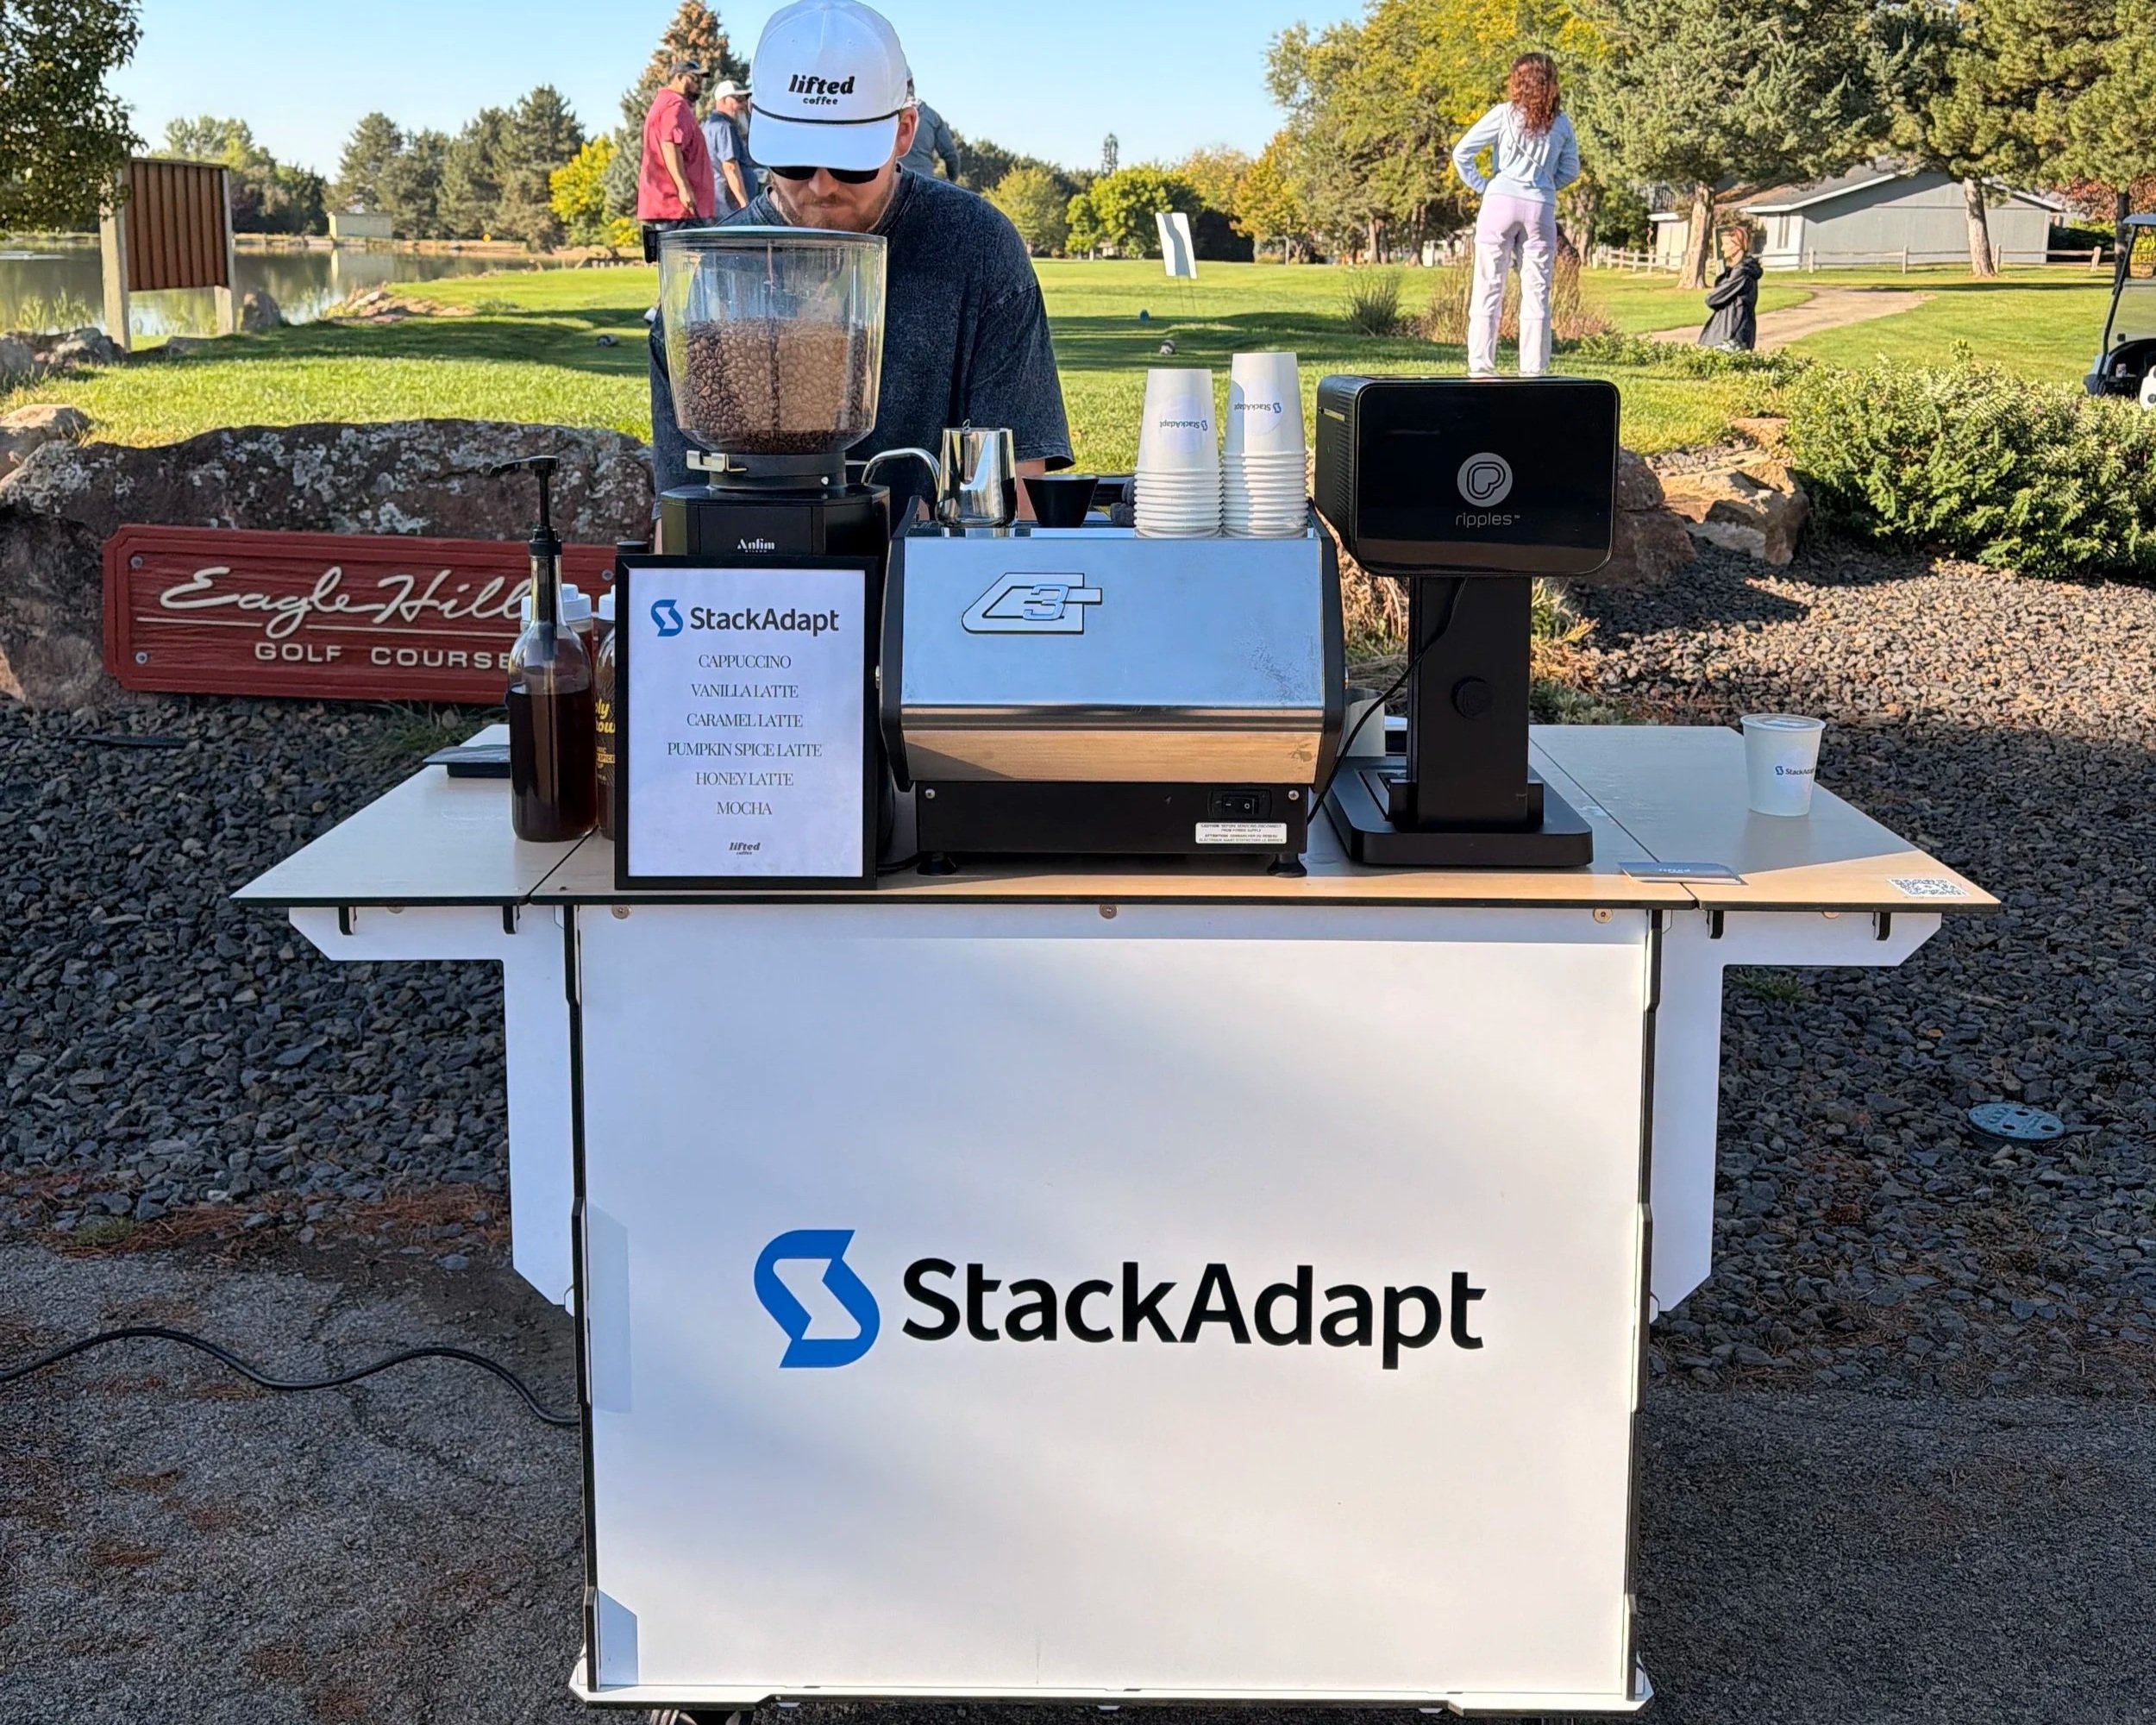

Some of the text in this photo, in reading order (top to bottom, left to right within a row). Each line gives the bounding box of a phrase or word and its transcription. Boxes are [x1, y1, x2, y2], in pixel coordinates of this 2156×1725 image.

[788, 74, 855, 95] lifted
[803, 96, 838, 105] coffee
[1159, 420, 1200, 430] StackAdapt
[160, 566, 531, 639] Eagle Hill
[690, 606, 840, 637] StackAdapt
[254, 642, 343, 662] GOLF
[698, 655, 792, 668] CAPPUCCINO
[691, 683, 799, 699] VANILLA LATTE
[686, 712, 803, 728] CARAMEL LATTE
[667, 742, 823, 757] PUMPKIN SPICE LATTE
[696, 771, 794, 787] HONEY LATTE
[717, 801, 773, 815] MOCHA
[729, 842, 761, 851] lifted
[901, 1257, 1487, 1371] StackAdapt
